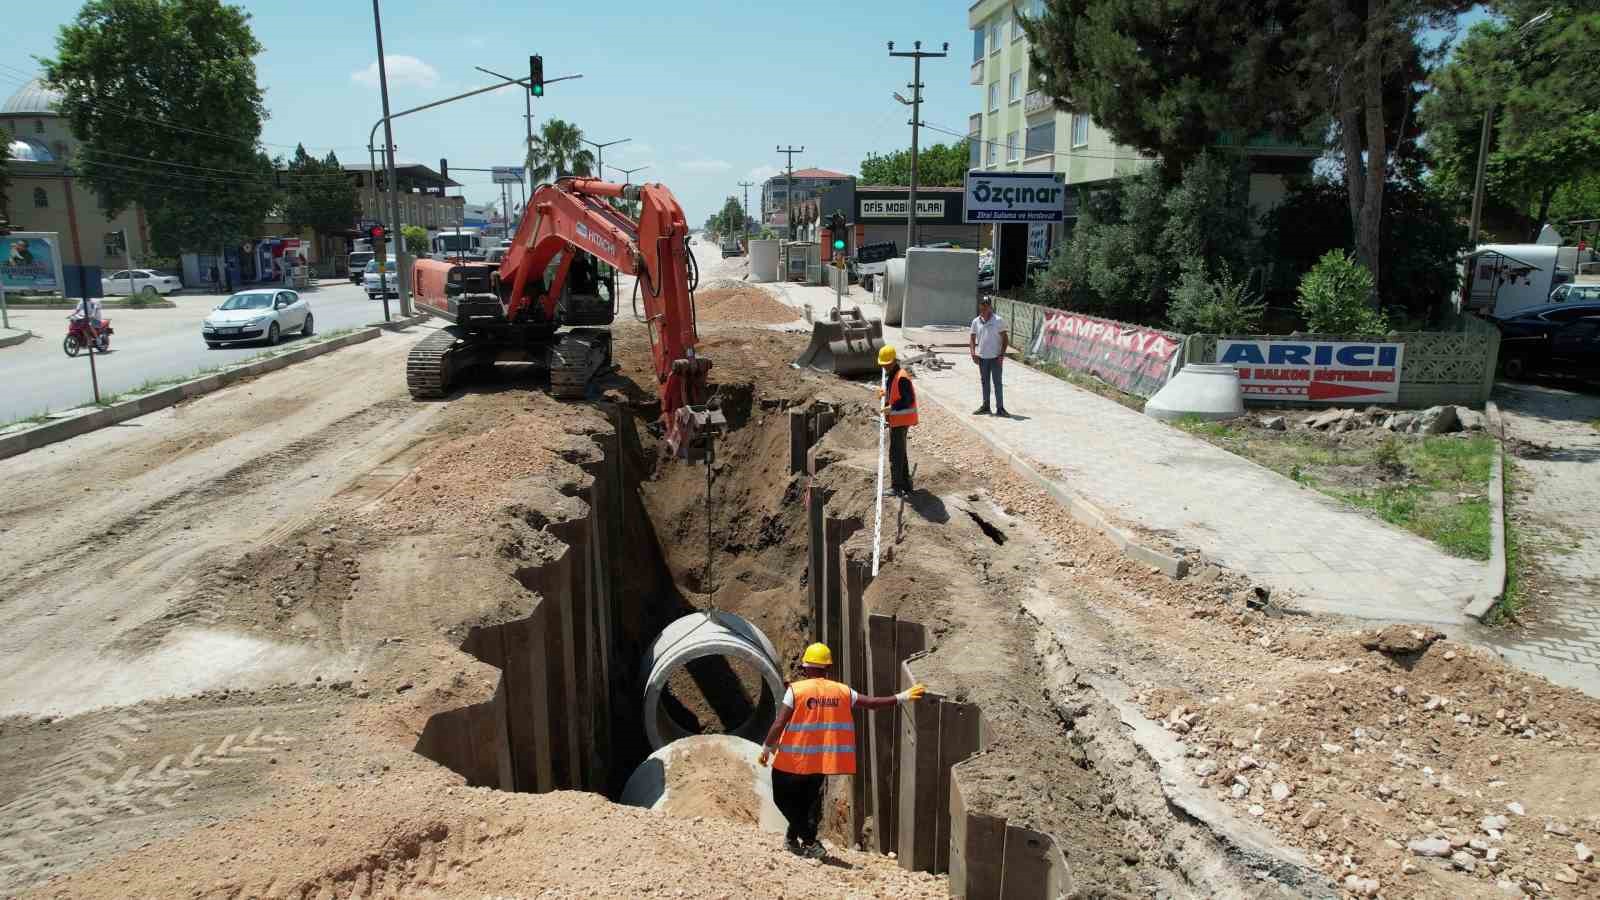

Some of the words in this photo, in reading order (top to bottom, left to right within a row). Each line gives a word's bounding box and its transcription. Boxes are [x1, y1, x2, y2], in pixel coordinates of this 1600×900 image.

[973, 180, 1062, 208] Özçınar
[885, 201, 942, 213] MOBİALARI
[588, 231, 615, 256] HITACHI
[1047, 314, 1165, 357] KAMPANYA
[1221, 344, 1397, 366] ARICI
